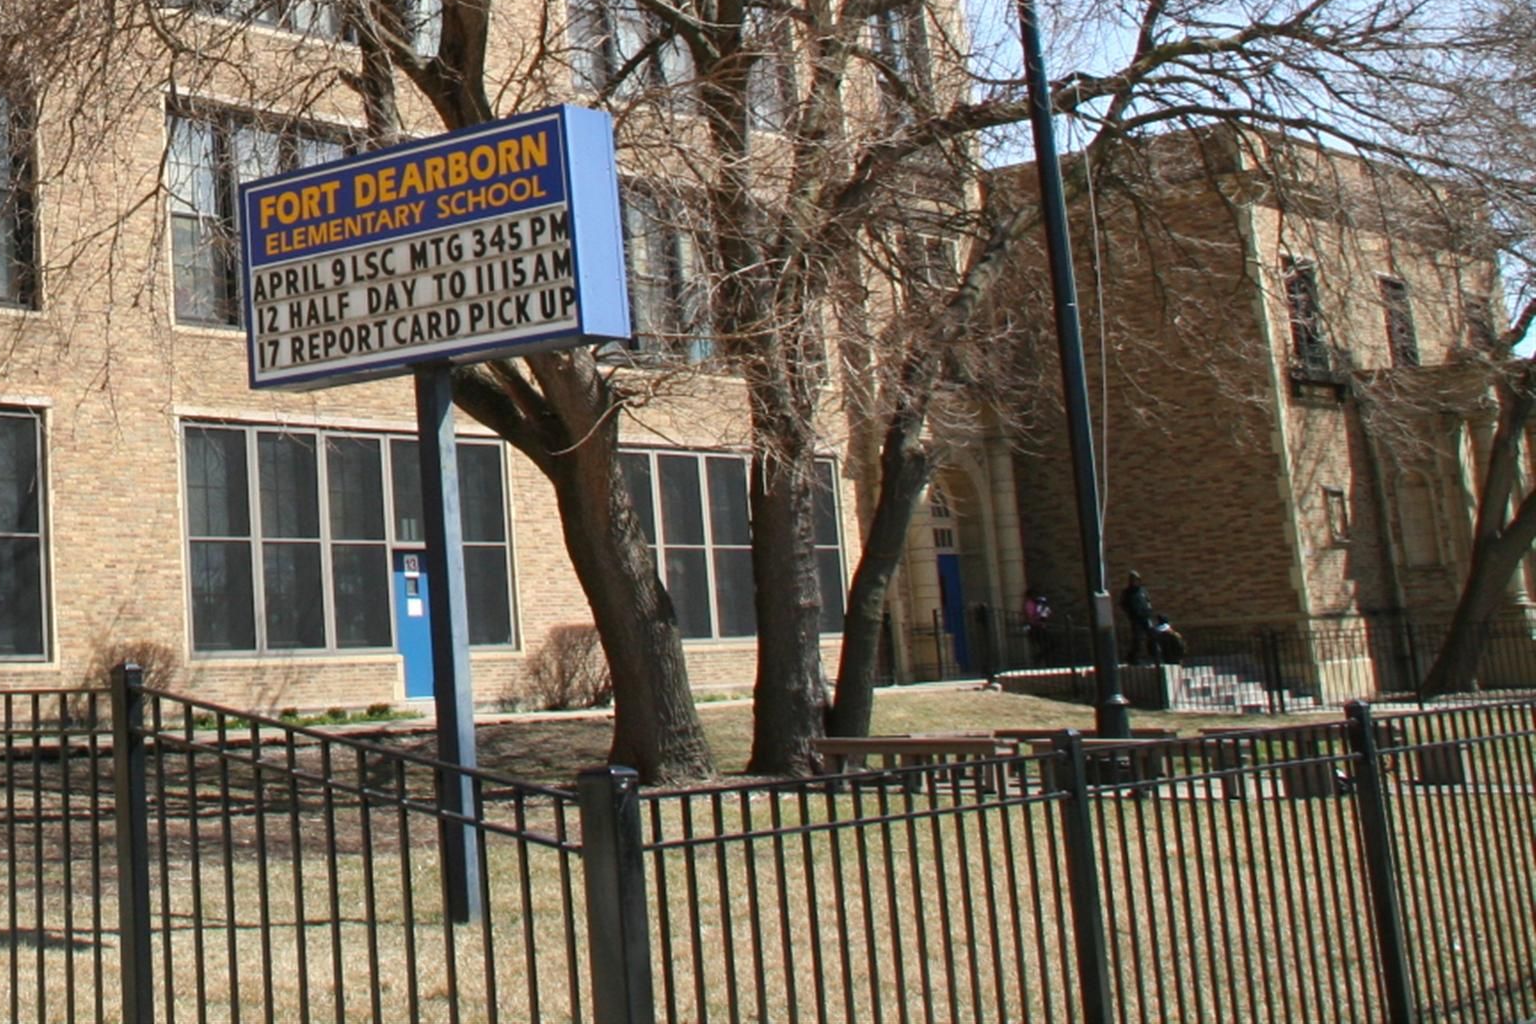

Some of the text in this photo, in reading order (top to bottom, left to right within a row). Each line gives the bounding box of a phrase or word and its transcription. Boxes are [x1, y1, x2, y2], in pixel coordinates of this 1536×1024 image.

[259, 131, 548, 229] FORT DEARBORN
[266, 175, 546, 256] ELEMENTARY SCHOOL
[254, 210, 569, 302] APRIL 9 LSC MTG 345 PM
[258, 248, 572, 334] 12 HALF DAY TO 1115 AM
[259, 286, 575, 369] 17 REPORT CARD PICK UP
